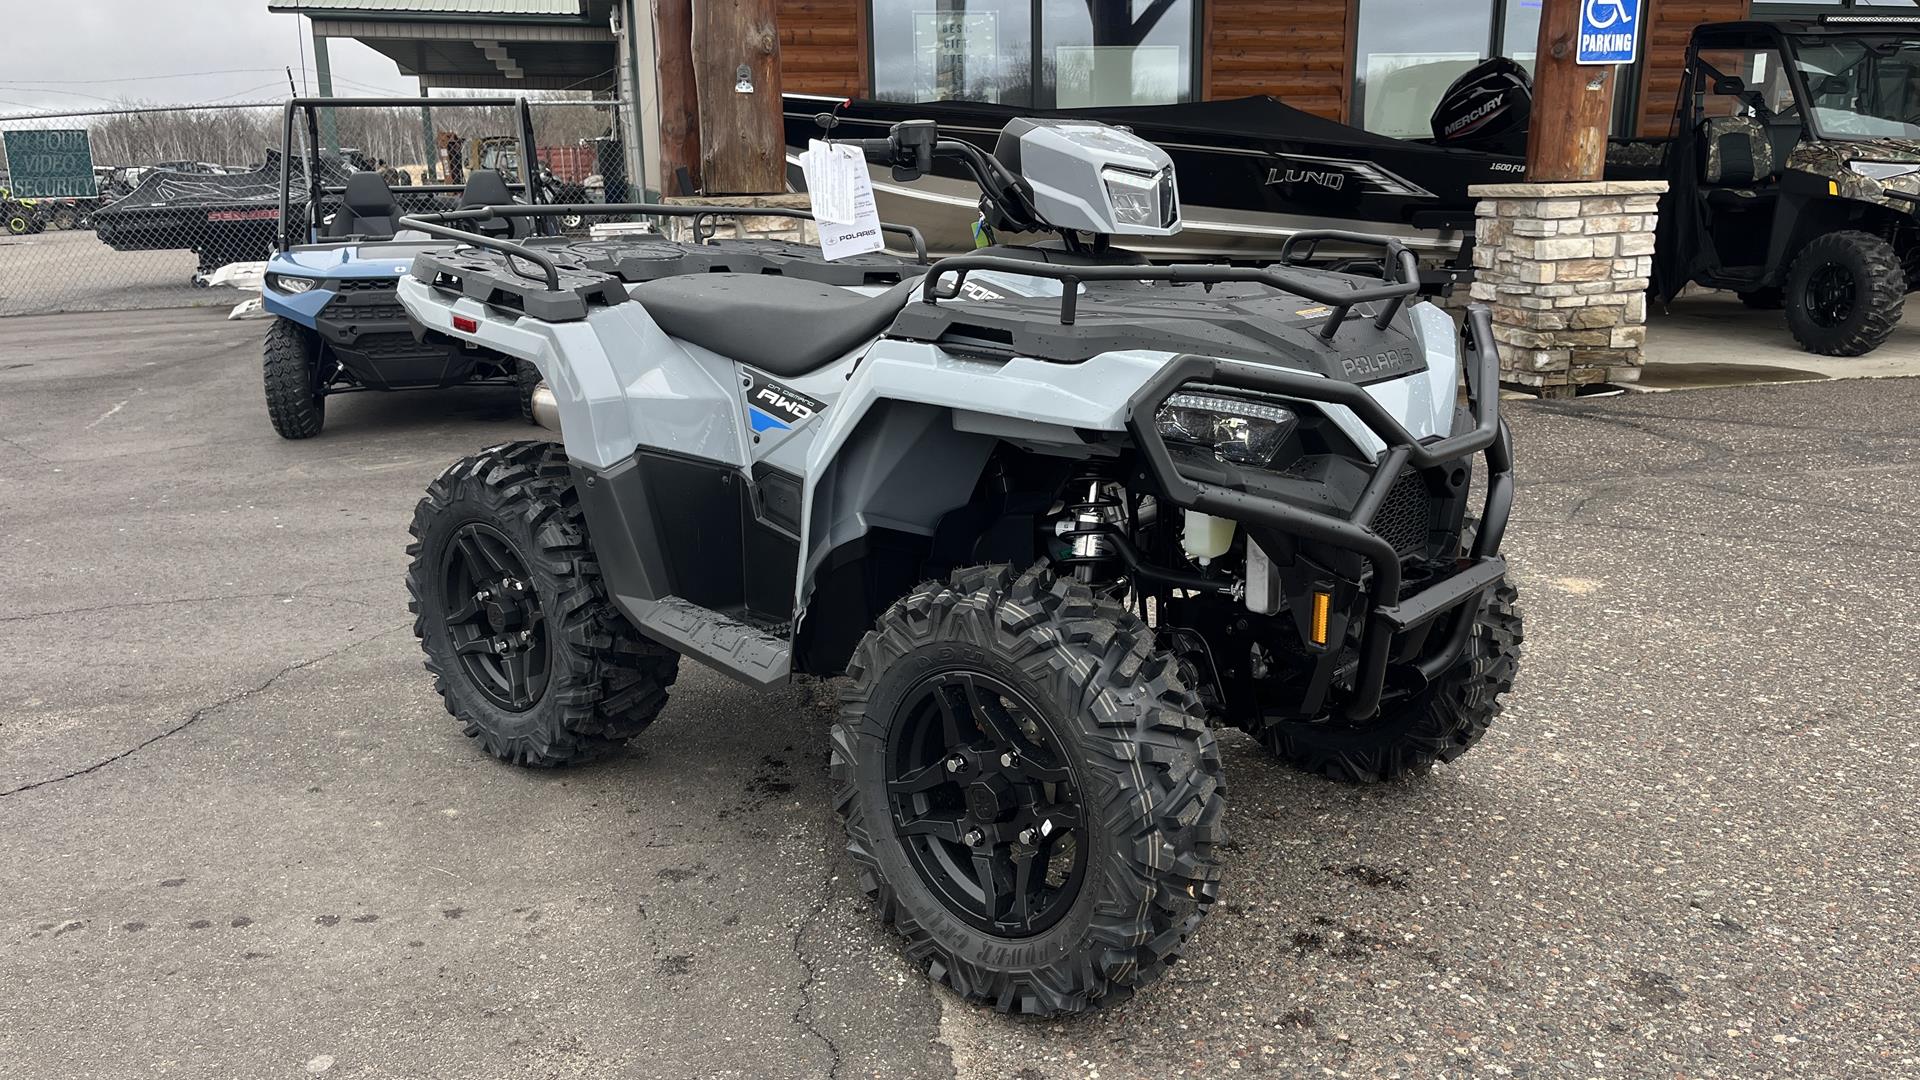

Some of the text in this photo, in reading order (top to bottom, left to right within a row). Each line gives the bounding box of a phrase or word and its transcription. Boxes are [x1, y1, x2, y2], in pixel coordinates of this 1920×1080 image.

[1581, 33, 1632, 52] PARKING
[1444, 93, 1504, 136] MERCURY
[23, 153, 76, 173] VIDEO
[1489, 162, 1512, 171] 1600
[14, 178, 94, 197] SECURITY
[1265, 168, 1345, 191] LUND
[839, 229, 877, 242] POLARIS
[1341, 347, 1414, 377] POLARIS
[756, 388, 812, 420] AWD
[767, 383, 815, 407] ON DEMAND
